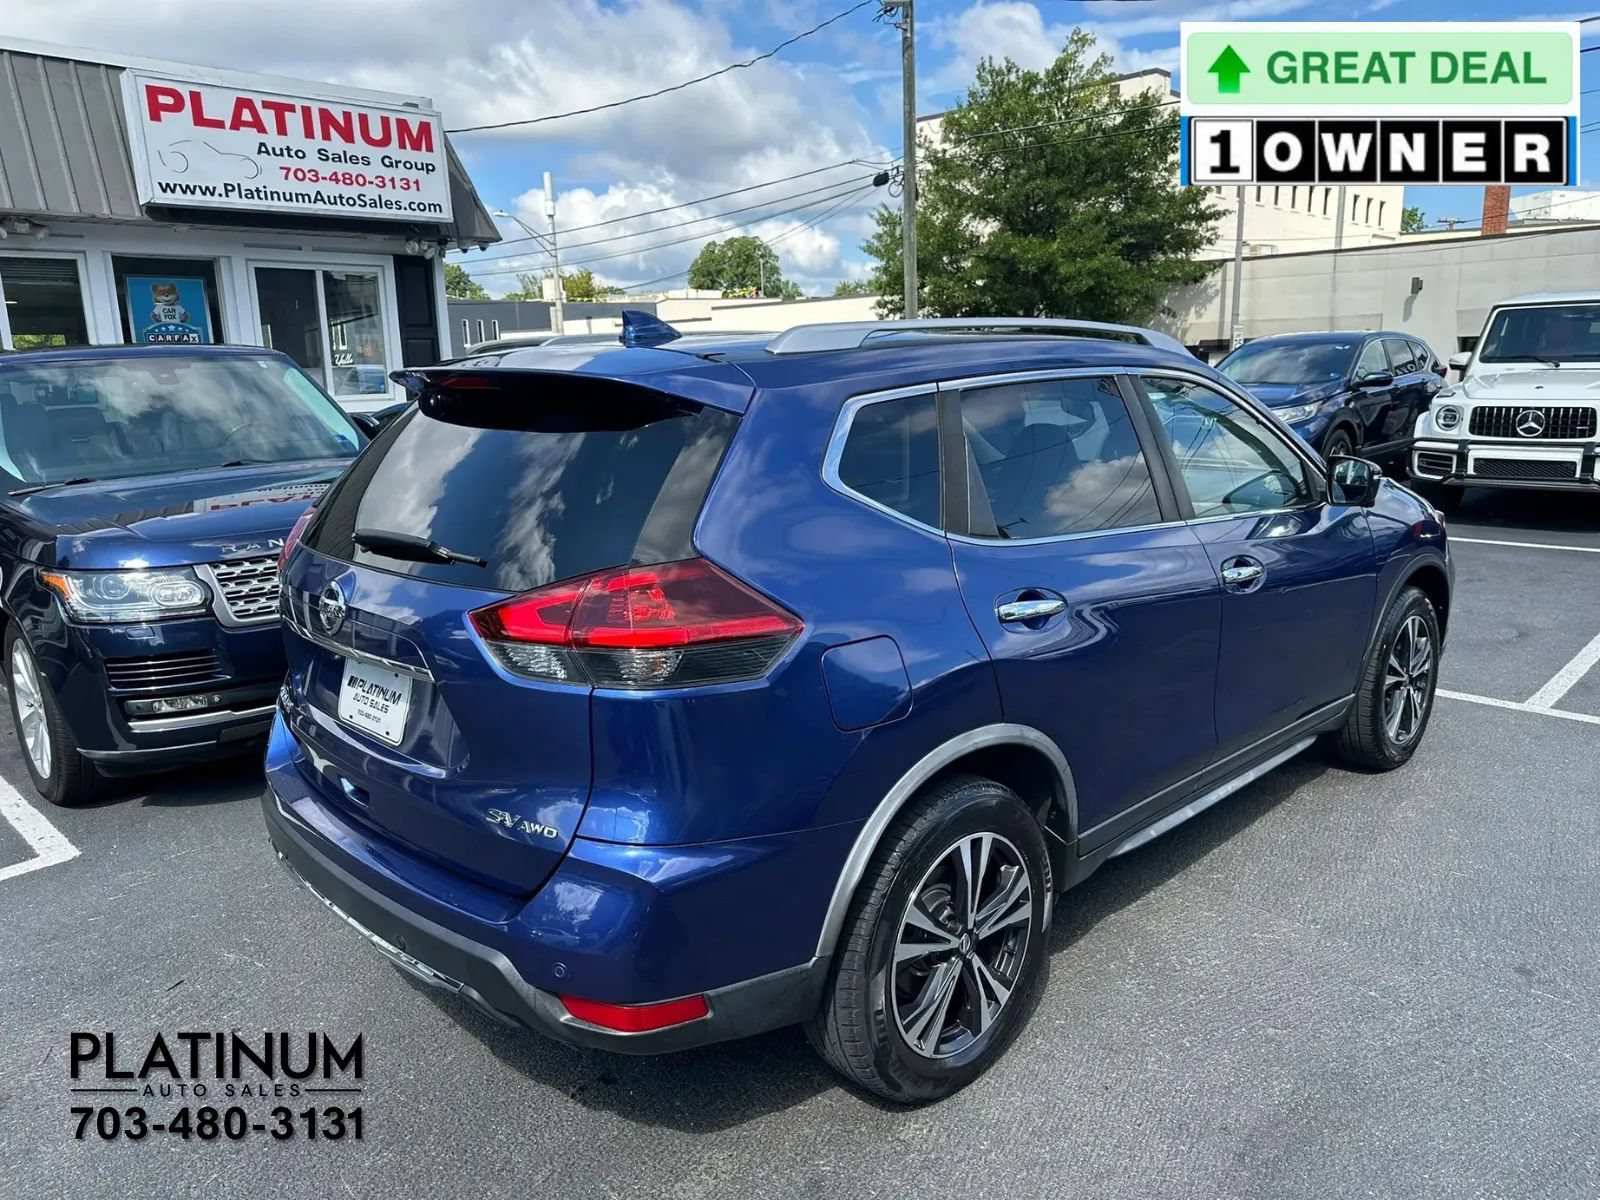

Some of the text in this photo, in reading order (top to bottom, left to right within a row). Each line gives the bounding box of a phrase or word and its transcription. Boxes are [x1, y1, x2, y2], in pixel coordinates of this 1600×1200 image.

[145, 84, 434, 153] PLATINUM
[257, 142, 436, 174] Auto Sales Group
[279, 166, 421, 192] 703-480-3131
[157, 181, 443, 213] www.PlatinumAutoSales.com
[148, 334, 198, 343] CARFAX
[353, 693, 390, 714] AUTO SALES
[356, 679, 402, 706] PLATINUM
[518, 820, 558, 838] AWD
